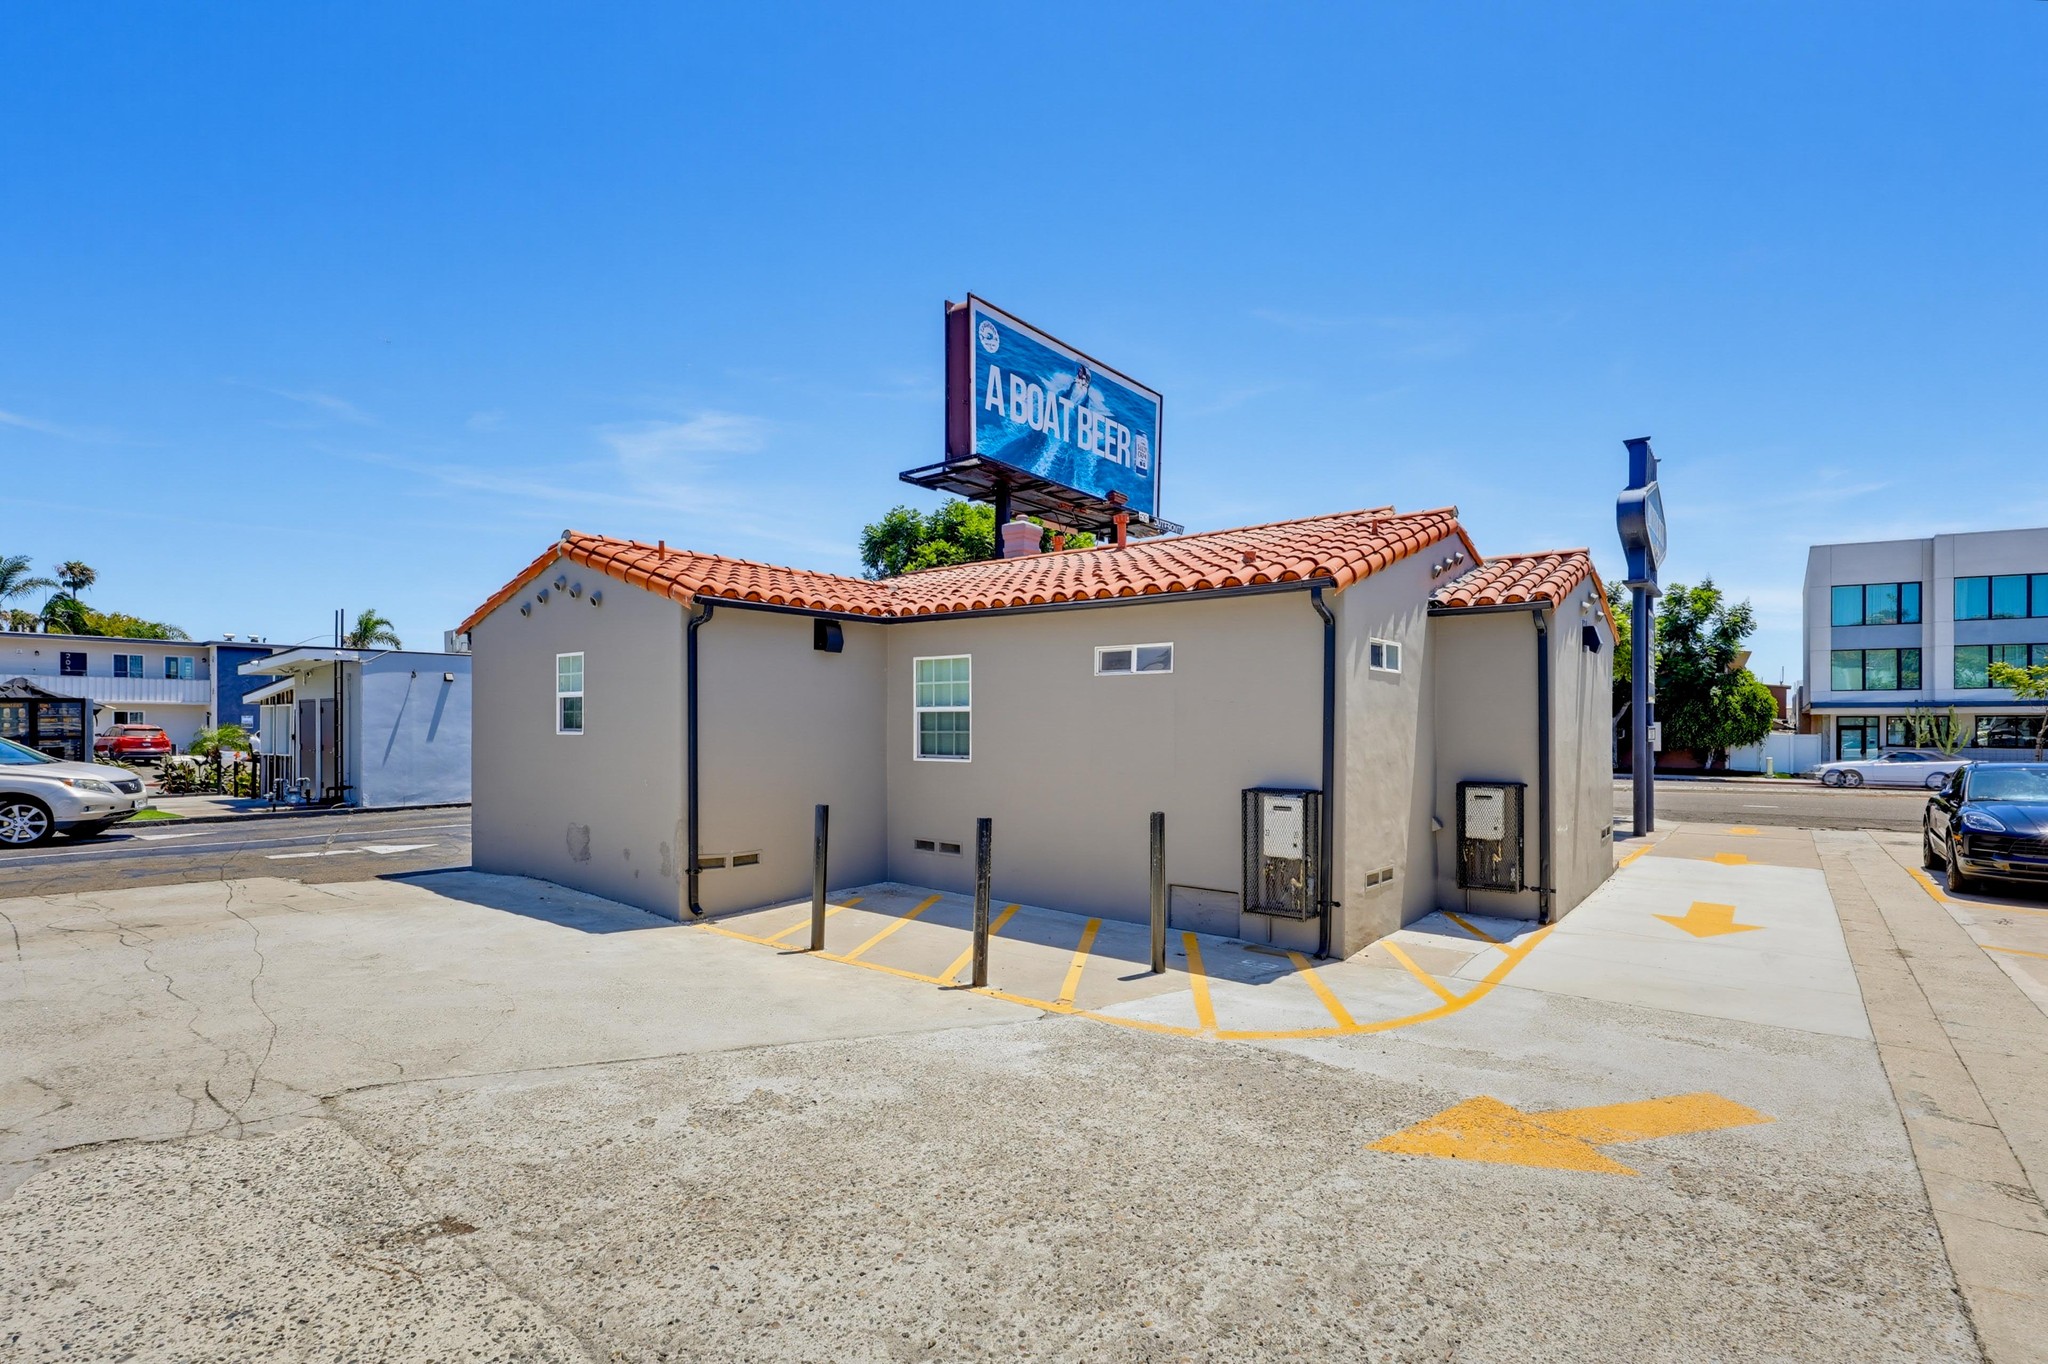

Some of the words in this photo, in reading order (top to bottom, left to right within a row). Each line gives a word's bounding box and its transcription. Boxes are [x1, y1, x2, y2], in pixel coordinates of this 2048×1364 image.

[985, 364, 1005, 417] A
[1010, 373, 1075, 443] BOAT
[1077, 405, 1131, 469] BEER
